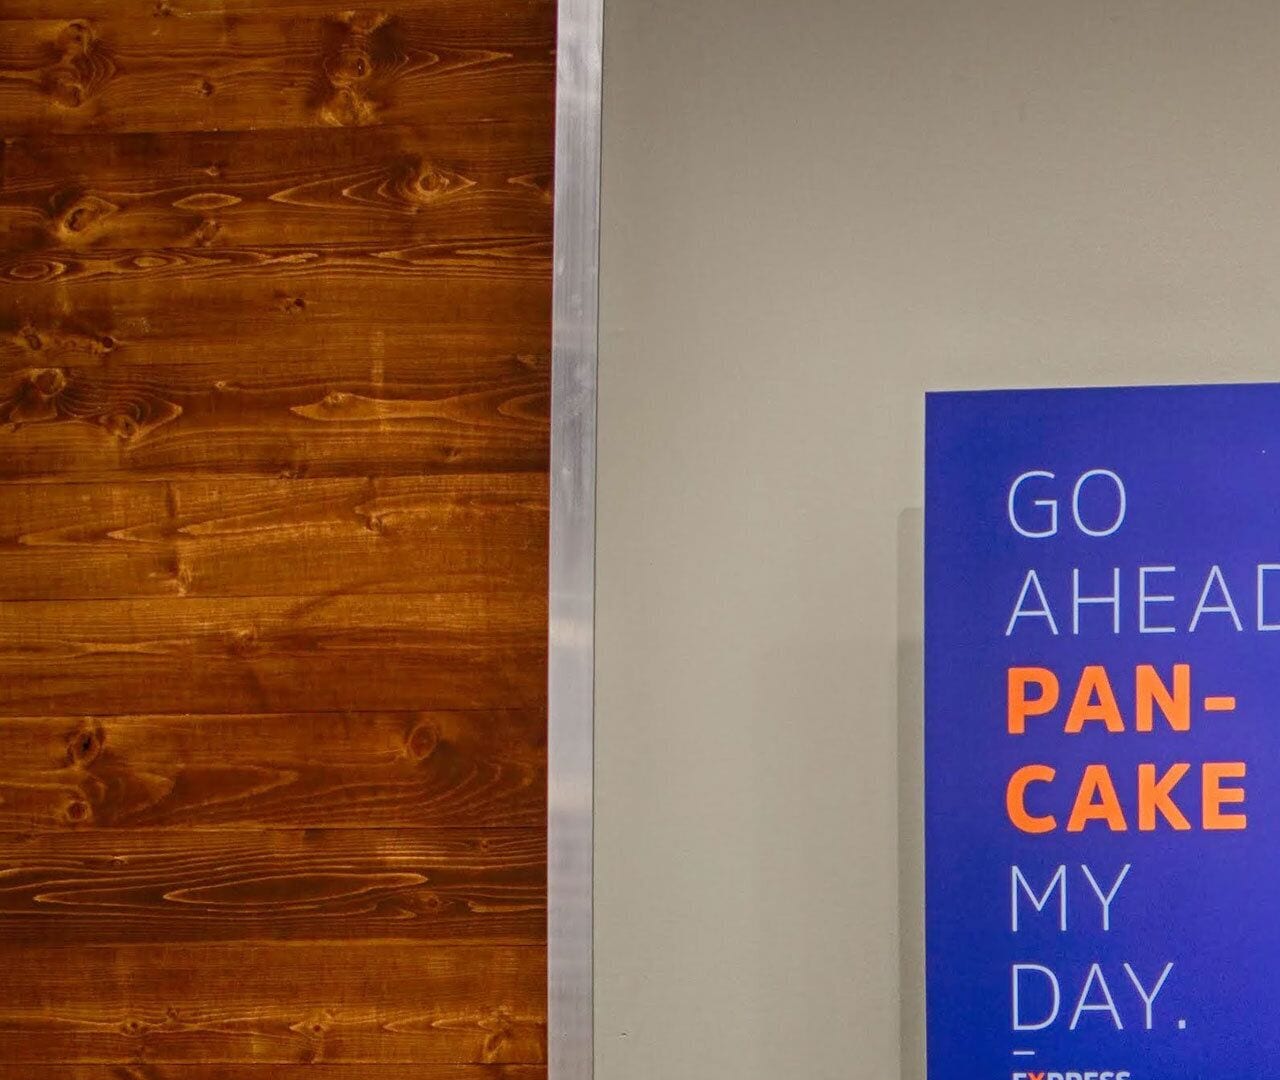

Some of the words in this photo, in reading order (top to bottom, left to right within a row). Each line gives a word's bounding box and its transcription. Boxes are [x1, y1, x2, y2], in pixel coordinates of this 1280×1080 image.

[1006, 468, 1128, 539] GO
[1005, 663, 1237, 734] PAN-
[1005, 761, 1248, 833] CAKE
[1010, 863, 1132, 933] MY
[1011, 962, 1187, 1031] DAY.
